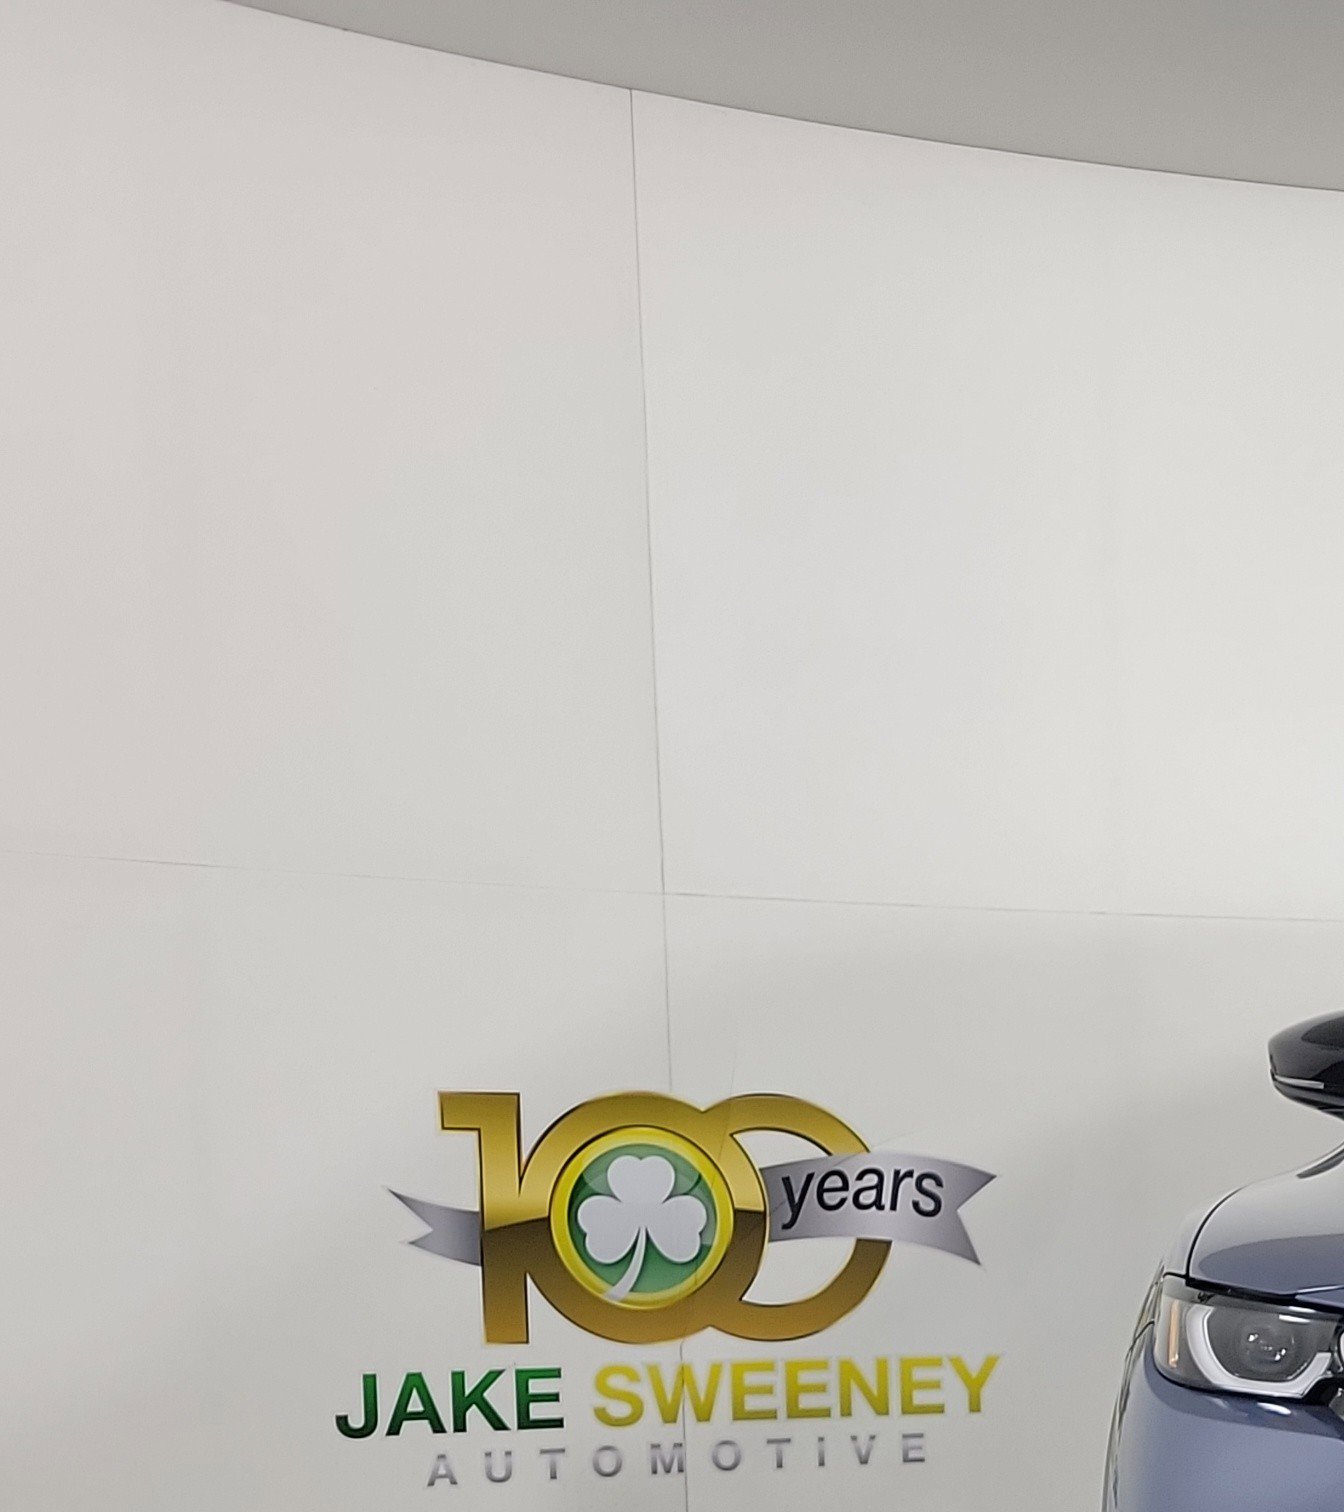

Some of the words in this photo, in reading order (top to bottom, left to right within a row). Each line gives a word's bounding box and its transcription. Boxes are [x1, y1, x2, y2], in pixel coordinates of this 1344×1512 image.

[438, 1090, 892, 1344] 100
[781, 1167, 944, 1230] years
[335, 1367, 564, 1438] JAKE
[593, 1355, 1000, 1427] SWEENEY
[427, 1433, 926, 1486] AUTOMOTIVE
